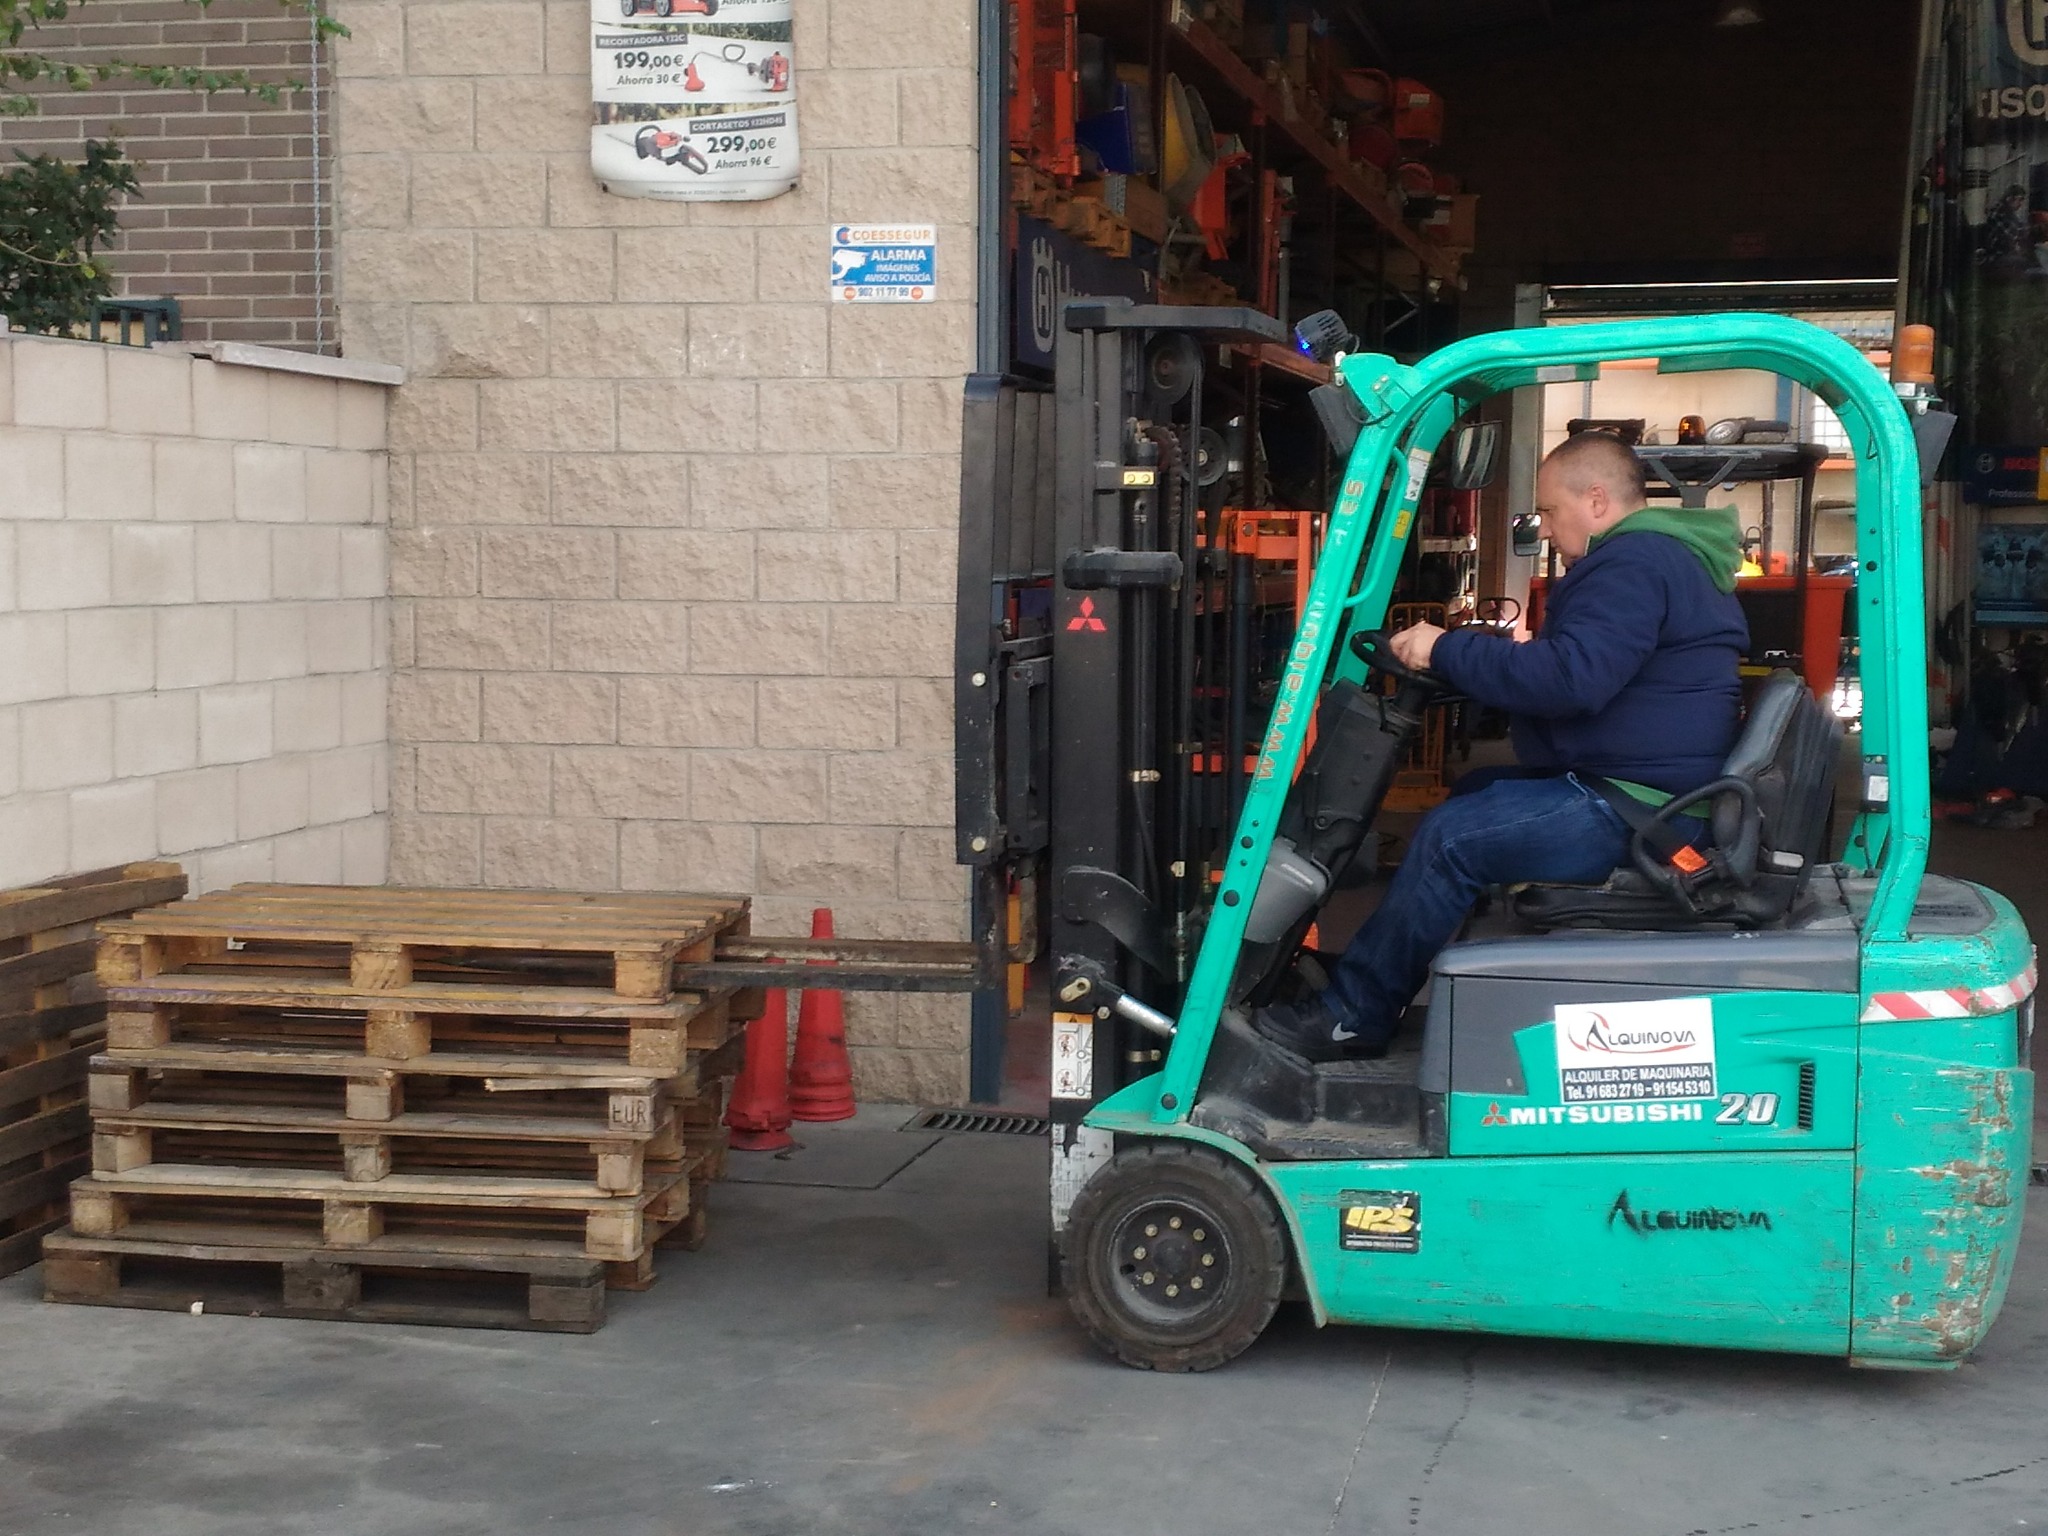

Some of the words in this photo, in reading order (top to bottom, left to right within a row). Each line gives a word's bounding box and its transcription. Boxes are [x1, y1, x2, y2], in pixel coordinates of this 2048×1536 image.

[599, 35, 664, 46] RECORTADORA
[617, 74, 653, 85] Ahorra
[656, 74, 669, 84] 30
[672, 73, 681, 83] €
[692, 120, 749, 131] CORTASETOS
[715, 159, 748, 169] Ahorra
[750, 157, 761, 166] 96
[764, 155, 772, 165] €
[871, 249, 926, 261] ALARMA
[876, 262, 921, 272] IMÁGENES
[864, 273, 890, 282] AVISO
[890, 274, 898, 282] A
[898, 272, 932, 282] POLICÍA
[858, 287, 873, 297] 902
[1564, 1068, 1620, 1084] ALQUILER
[1621, 1067, 1639, 1081] DE
[1639, 1065, 1712, 1080] MAQUINARIA
[612, 1100, 647, 1124] EUR
[1510, 1103, 1703, 1125] MITSUBISHI
[1715, 1092, 1778, 1125] 20
